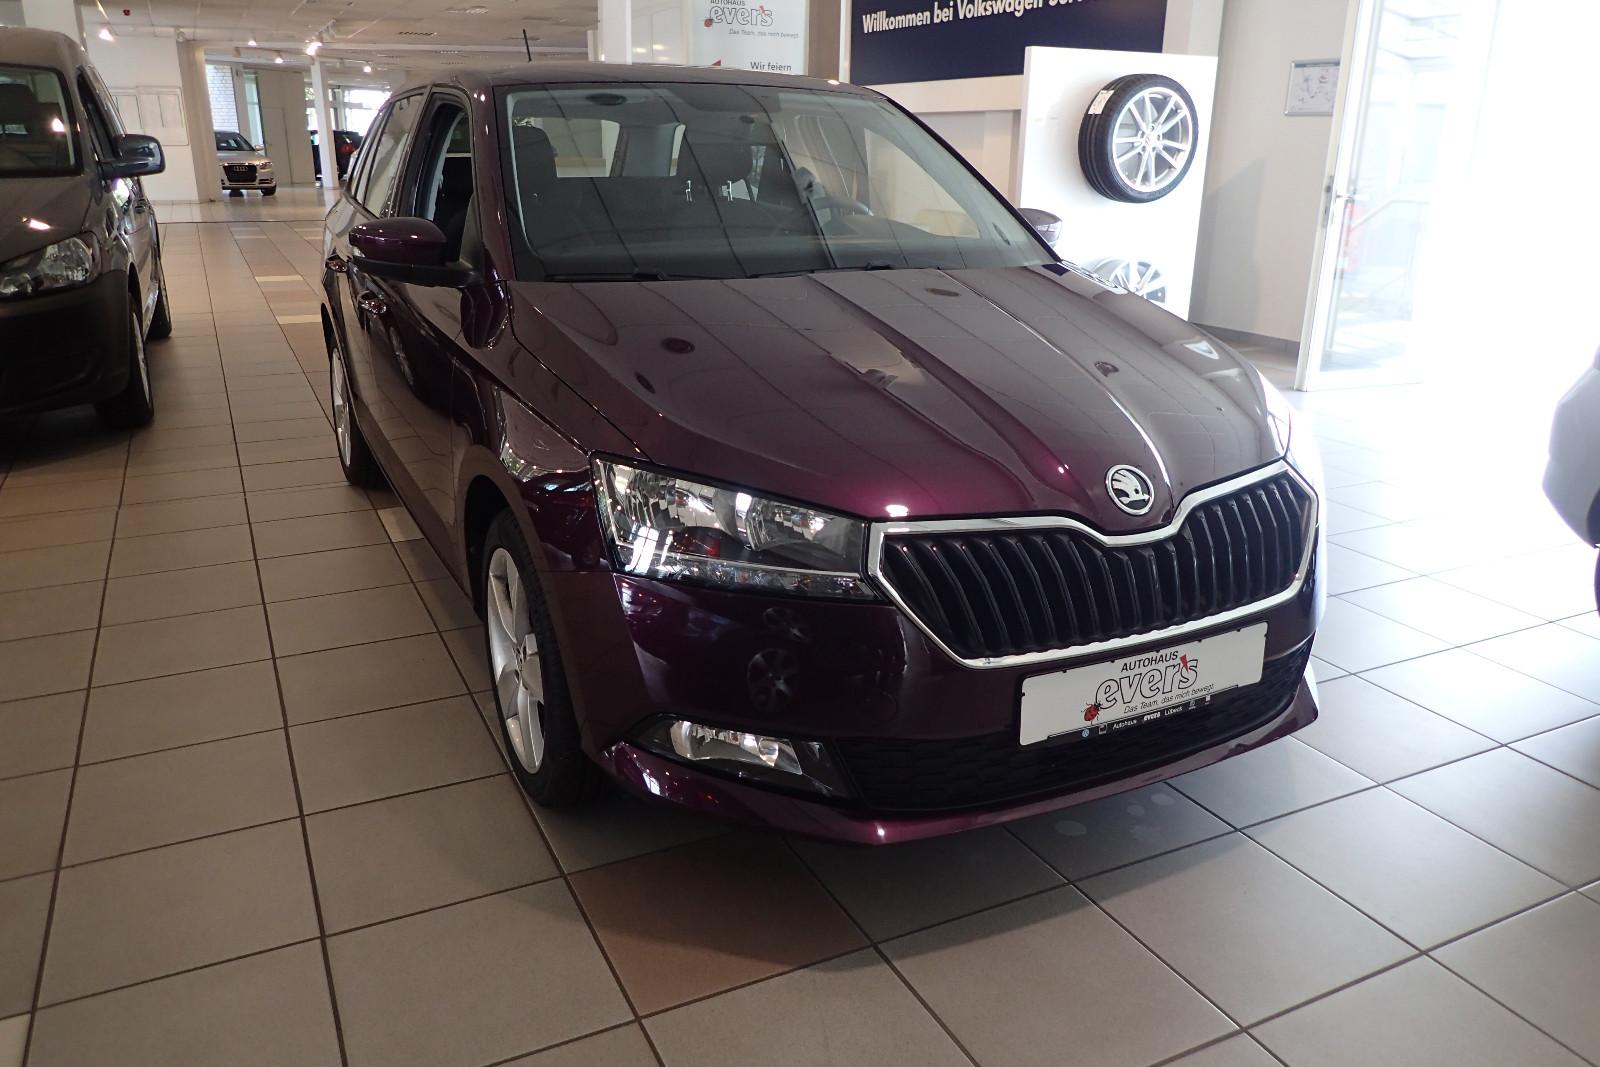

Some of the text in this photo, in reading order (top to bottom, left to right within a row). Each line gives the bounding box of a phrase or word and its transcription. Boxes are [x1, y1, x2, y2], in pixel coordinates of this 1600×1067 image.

[862, 10, 931, 34] Willkommen
[933, 1, 954, 24] bei
[750, 61, 792, 71] Wir feiern
[1121, 650, 1179, 672] AUTOHAUS
[1123, 705, 1138, 714] Das
[1161, 696, 1173, 705] das
[1174, 691, 1191, 701] mich
[1191, 683, 1215, 697] bewegt
